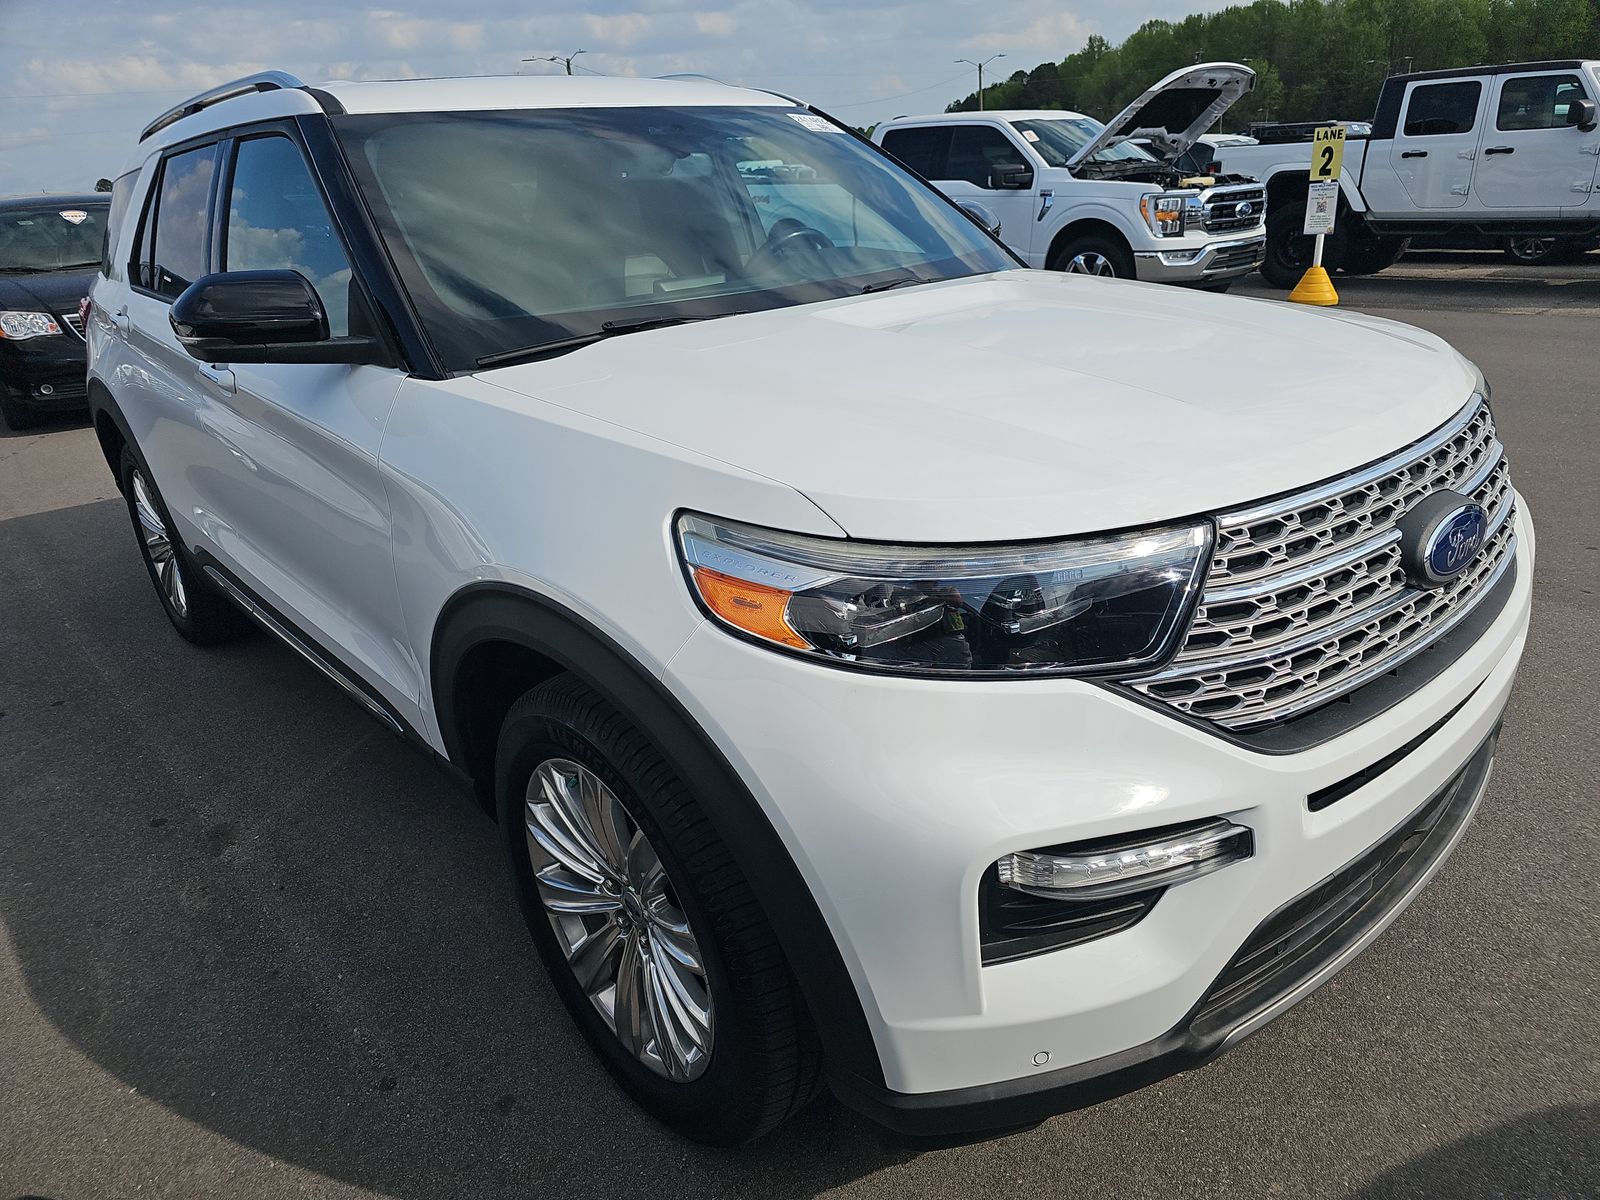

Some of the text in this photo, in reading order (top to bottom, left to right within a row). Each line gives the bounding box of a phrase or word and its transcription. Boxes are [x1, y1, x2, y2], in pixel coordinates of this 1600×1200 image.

[1316, 129, 1344, 141] LANE
[1319, 146, 1334, 176] 2
[1447, 520, 1480, 567] Ford
[703, 551, 798, 582] EXPLORER
